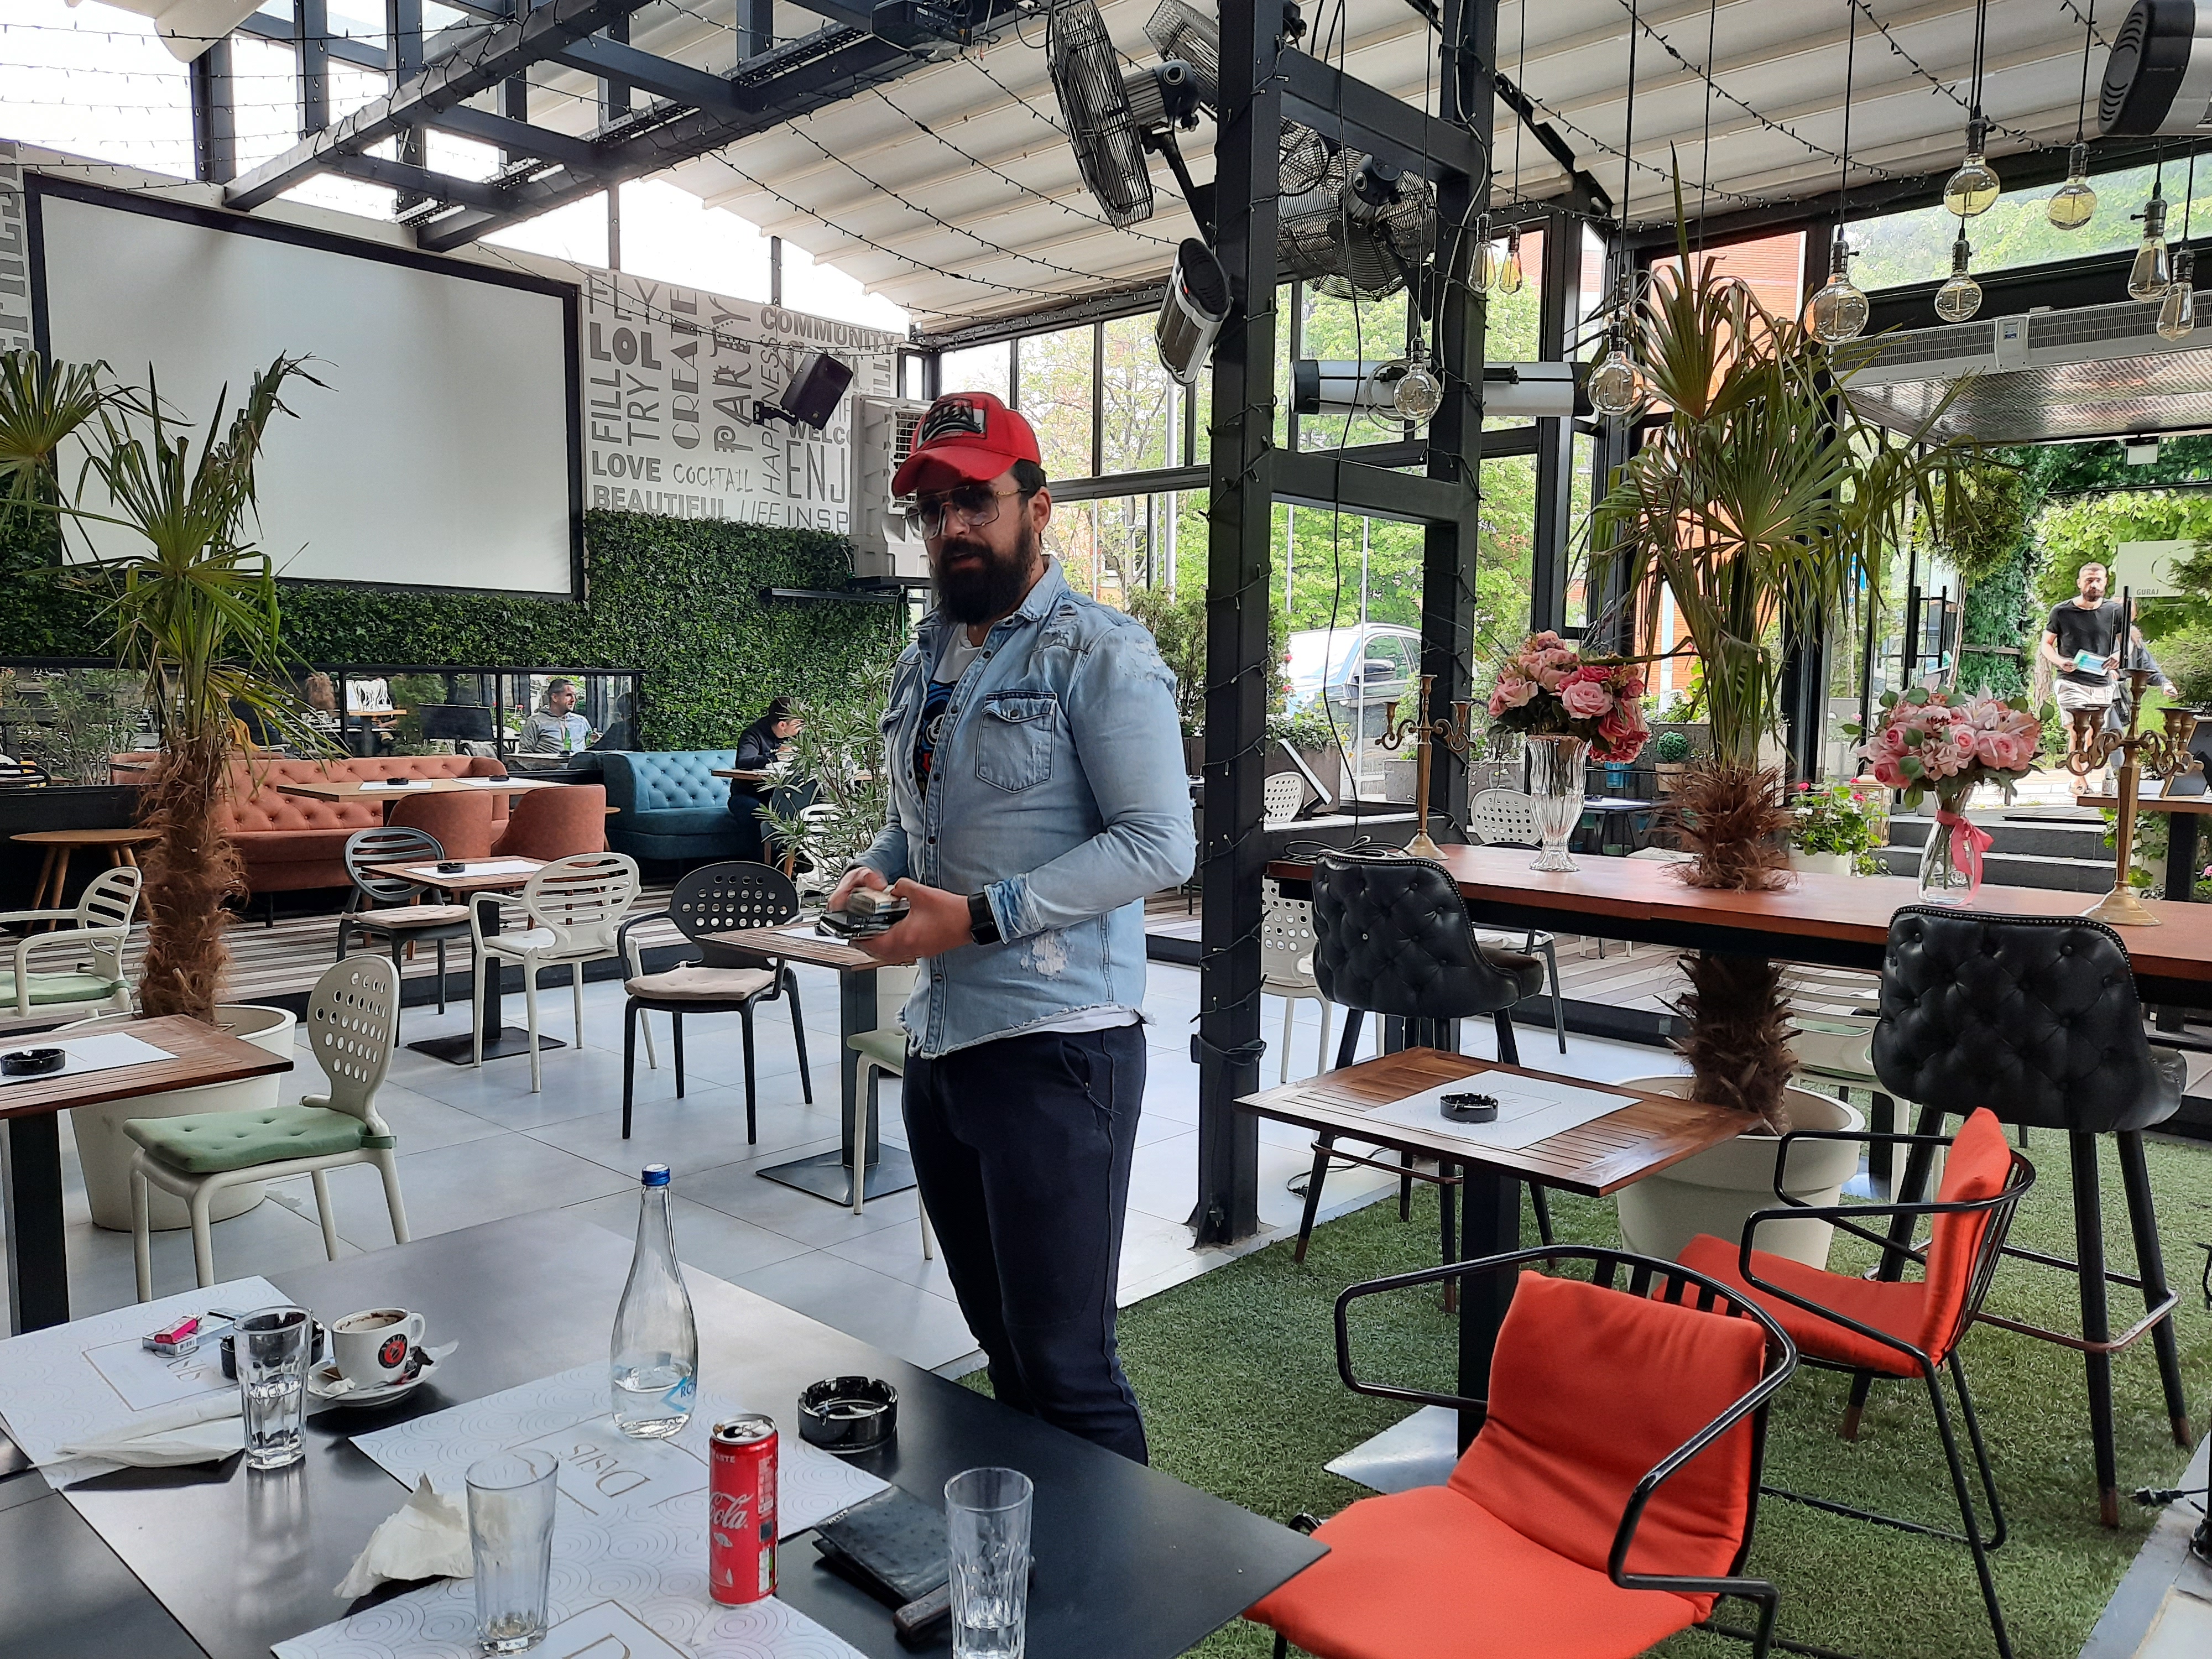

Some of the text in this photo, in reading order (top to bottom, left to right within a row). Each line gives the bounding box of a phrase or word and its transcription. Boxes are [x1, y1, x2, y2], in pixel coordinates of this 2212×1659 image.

[588, 269, 659, 325] FLY
[589, 321, 662, 371] LOL
[761, 307, 895, 354] COMMUNITY
[670, 288, 700, 450] CREATE
[708, 295, 754, 453] PARTY
[590, 369, 622, 444] FILL
[626, 373, 660, 446] TRY
[761, 334, 781, 495] HAPPNESS
[789, 419, 850, 445] WELC
[592, 450, 661, 482] LOVE
[673, 463, 753, 493] COCKTAIL
[786, 440, 845, 503] ENJ
[593, 484, 731, 520] BEAUTIFUL
[787, 505, 848, 531] INSP
